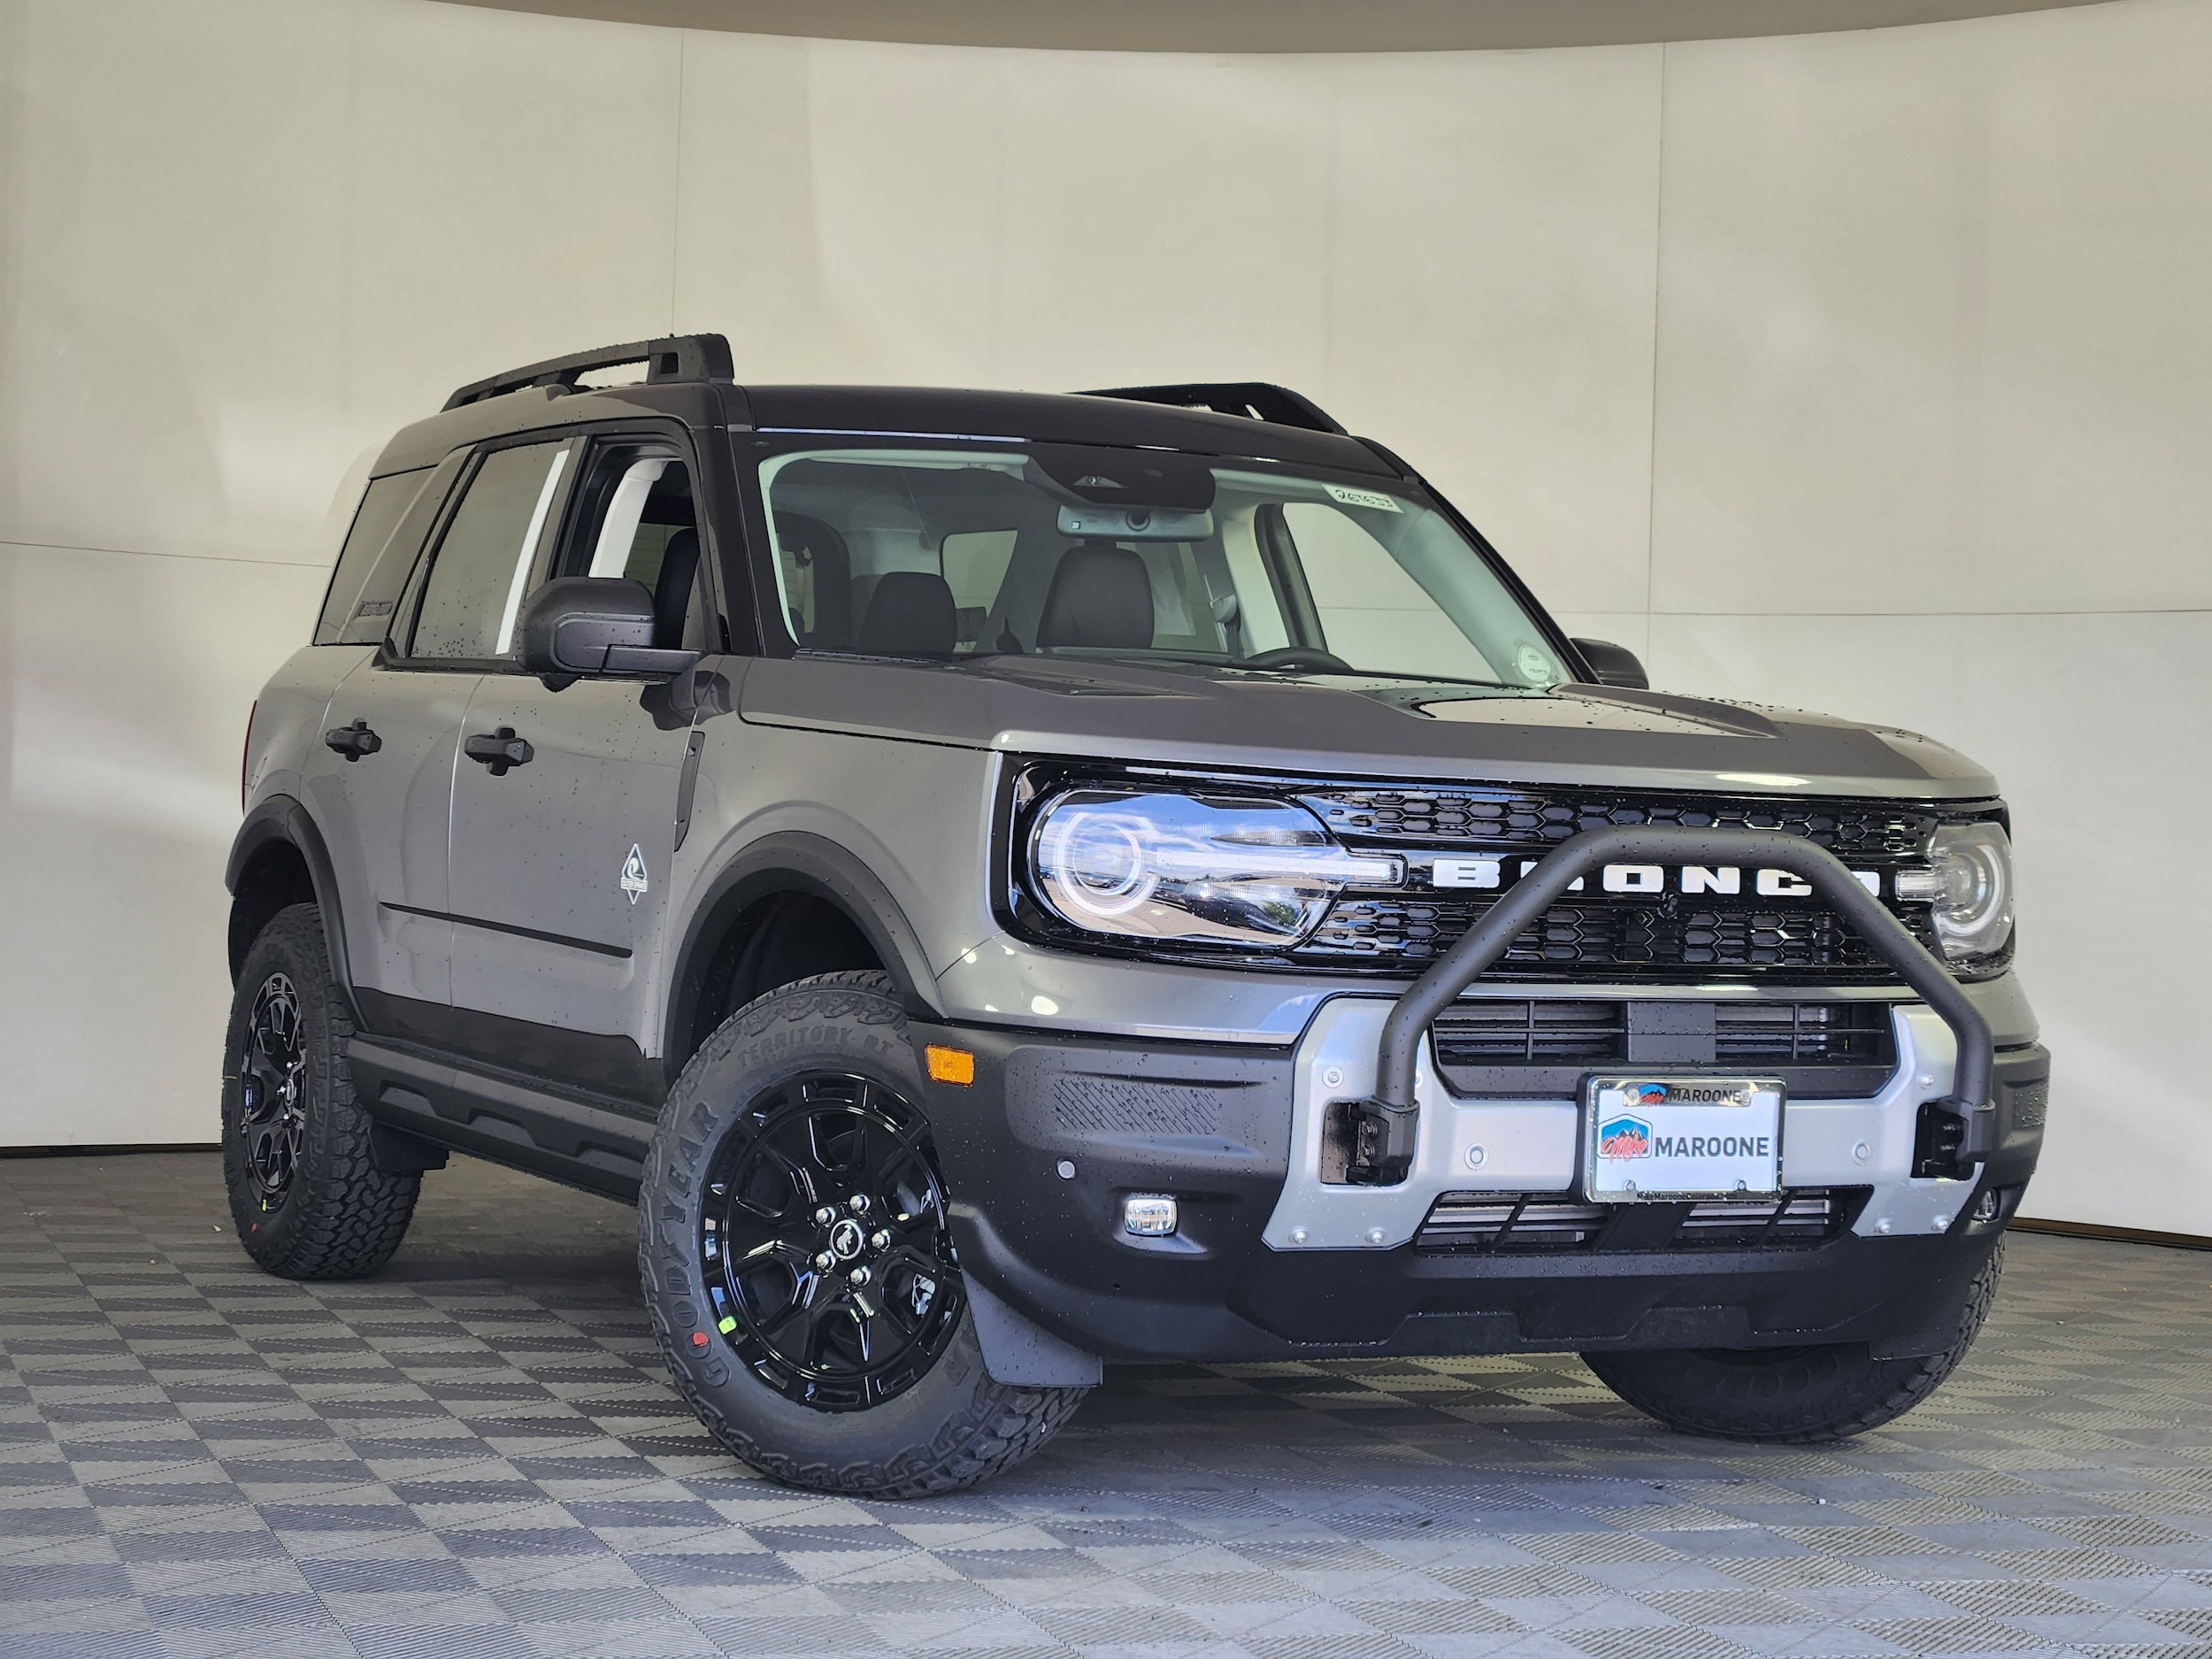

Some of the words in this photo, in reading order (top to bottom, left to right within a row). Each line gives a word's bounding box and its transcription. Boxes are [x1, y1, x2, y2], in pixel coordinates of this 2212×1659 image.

[1433, 859, 1880, 897] BONC
[737, 1025, 852, 1069] TERRITORY
[863, 1033, 894, 1058] RT
[1669, 1089, 1741, 1102] MAROONE
[1601, 1135, 1648, 1164] Mike
[1655, 1136, 1770, 1157] MAROONE
[658, 1102, 730, 1387] GOODYEAR
